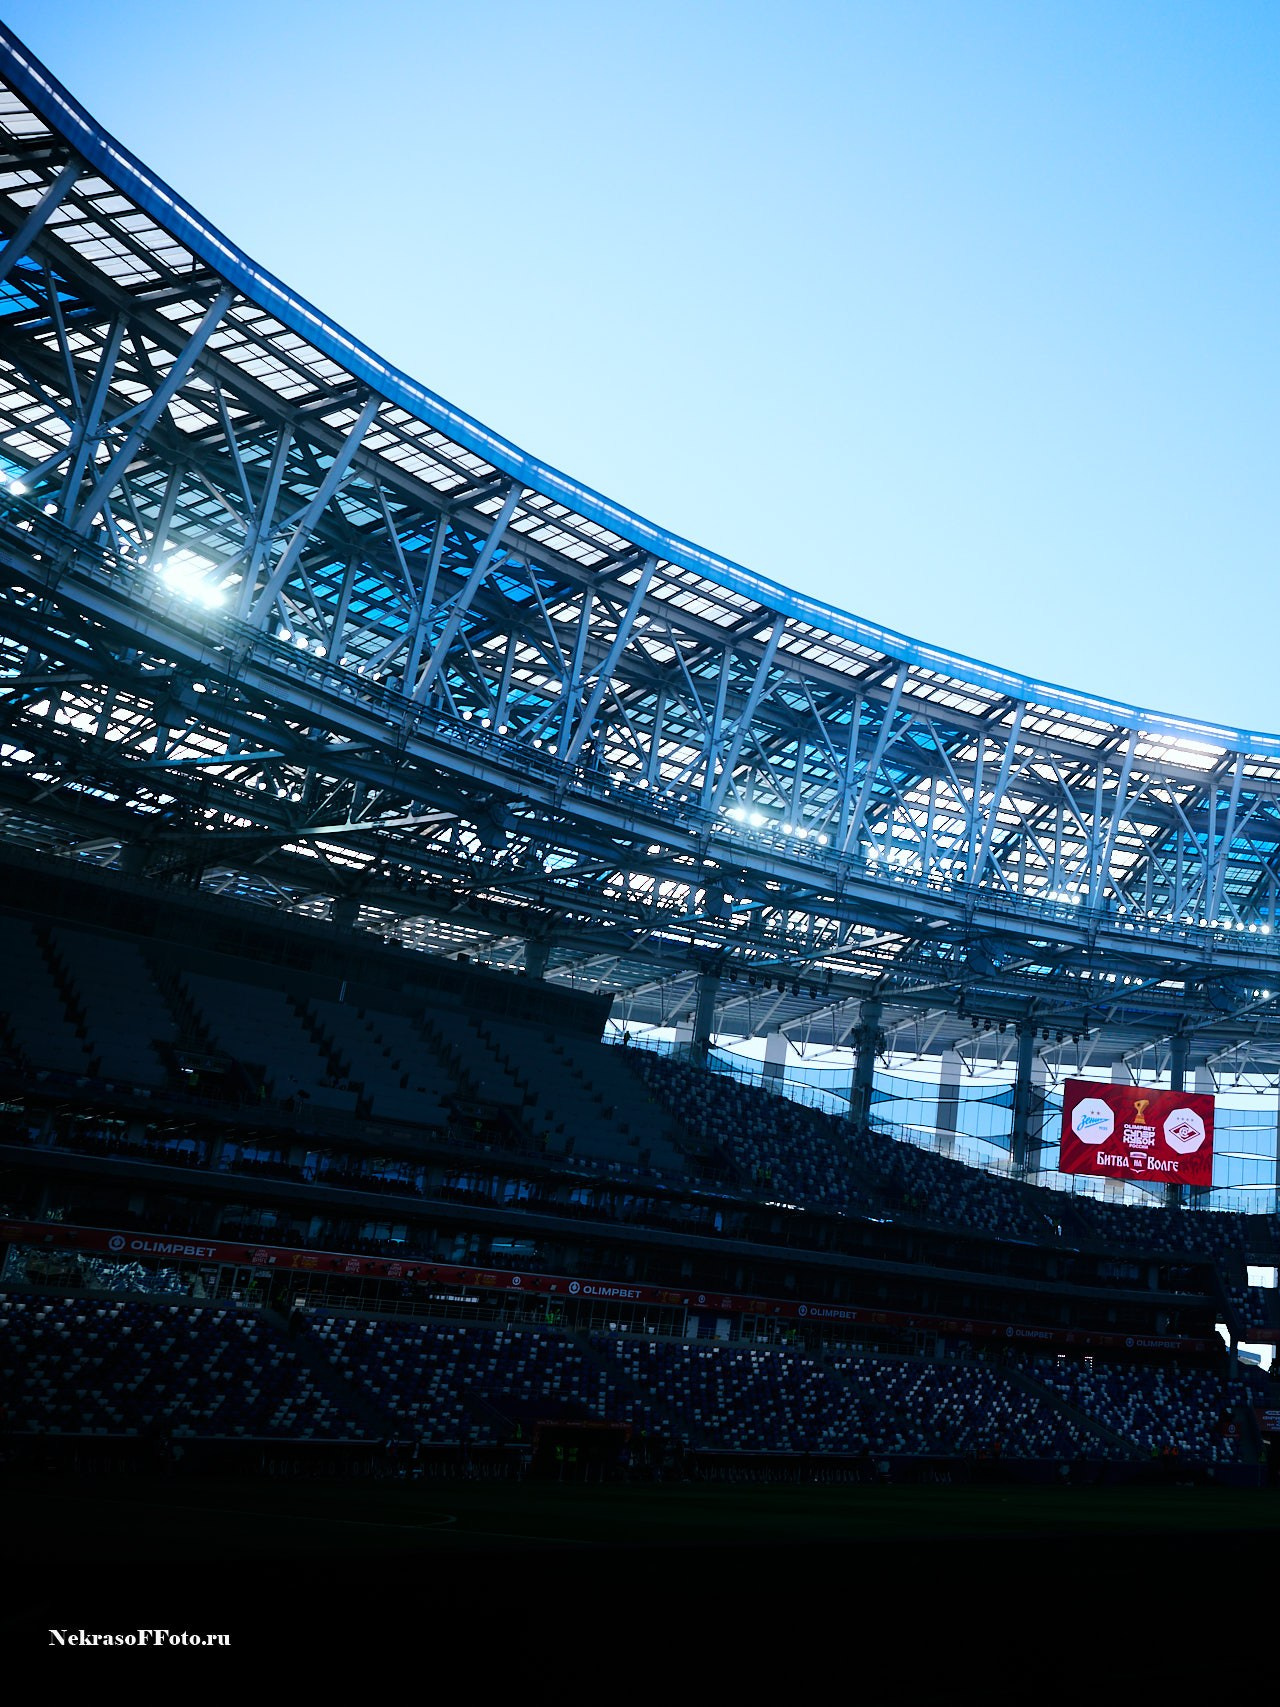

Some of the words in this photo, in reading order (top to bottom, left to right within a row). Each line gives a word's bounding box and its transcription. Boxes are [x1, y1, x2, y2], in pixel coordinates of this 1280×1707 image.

[130, 1240, 216, 1258] OLIMPBET
[582, 1285, 642, 1299] OLIMPBET
[810, 1307, 858, 1319] OLIMPBET
